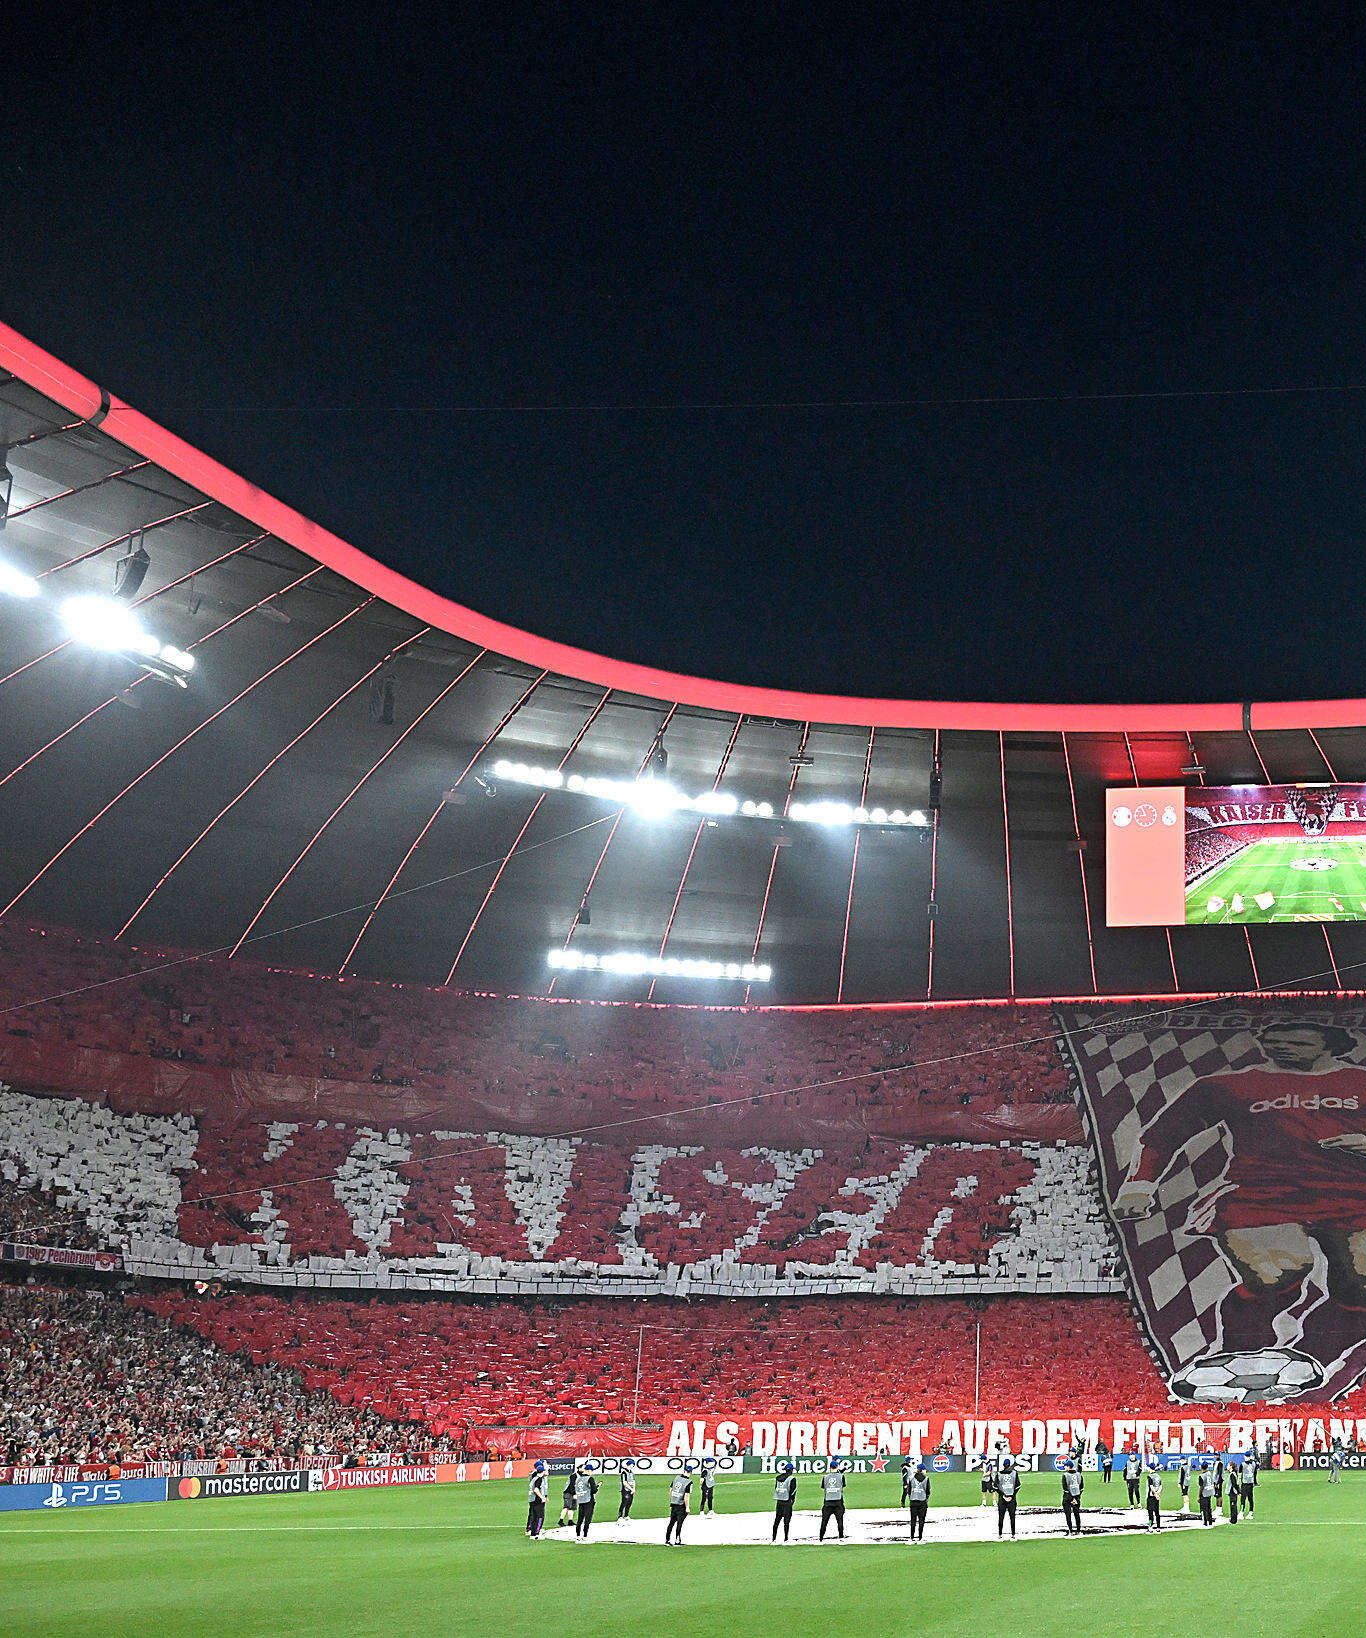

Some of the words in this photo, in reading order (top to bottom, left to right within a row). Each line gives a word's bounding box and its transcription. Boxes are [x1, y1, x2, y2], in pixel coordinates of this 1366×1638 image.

[1249, 1093, 1359, 1113] adidas
[667, 1420, 740, 1456] ALS
[752, 1420, 929, 1456] DIRIGENT
[941, 1418, 1011, 1455] AUF
[1021, 1418, 1100, 1454] DEM
[585, 1457, 652, 1474] oppo
[667, 1457, 734, 1474] oppo
[205, 1472, 301, 1495] mastercard
[341, 1469, 389, 1487] TURKISH
[391, 1466, 435, 1484] AIRLINES
[71, 1483, 122, 1503] PS5
